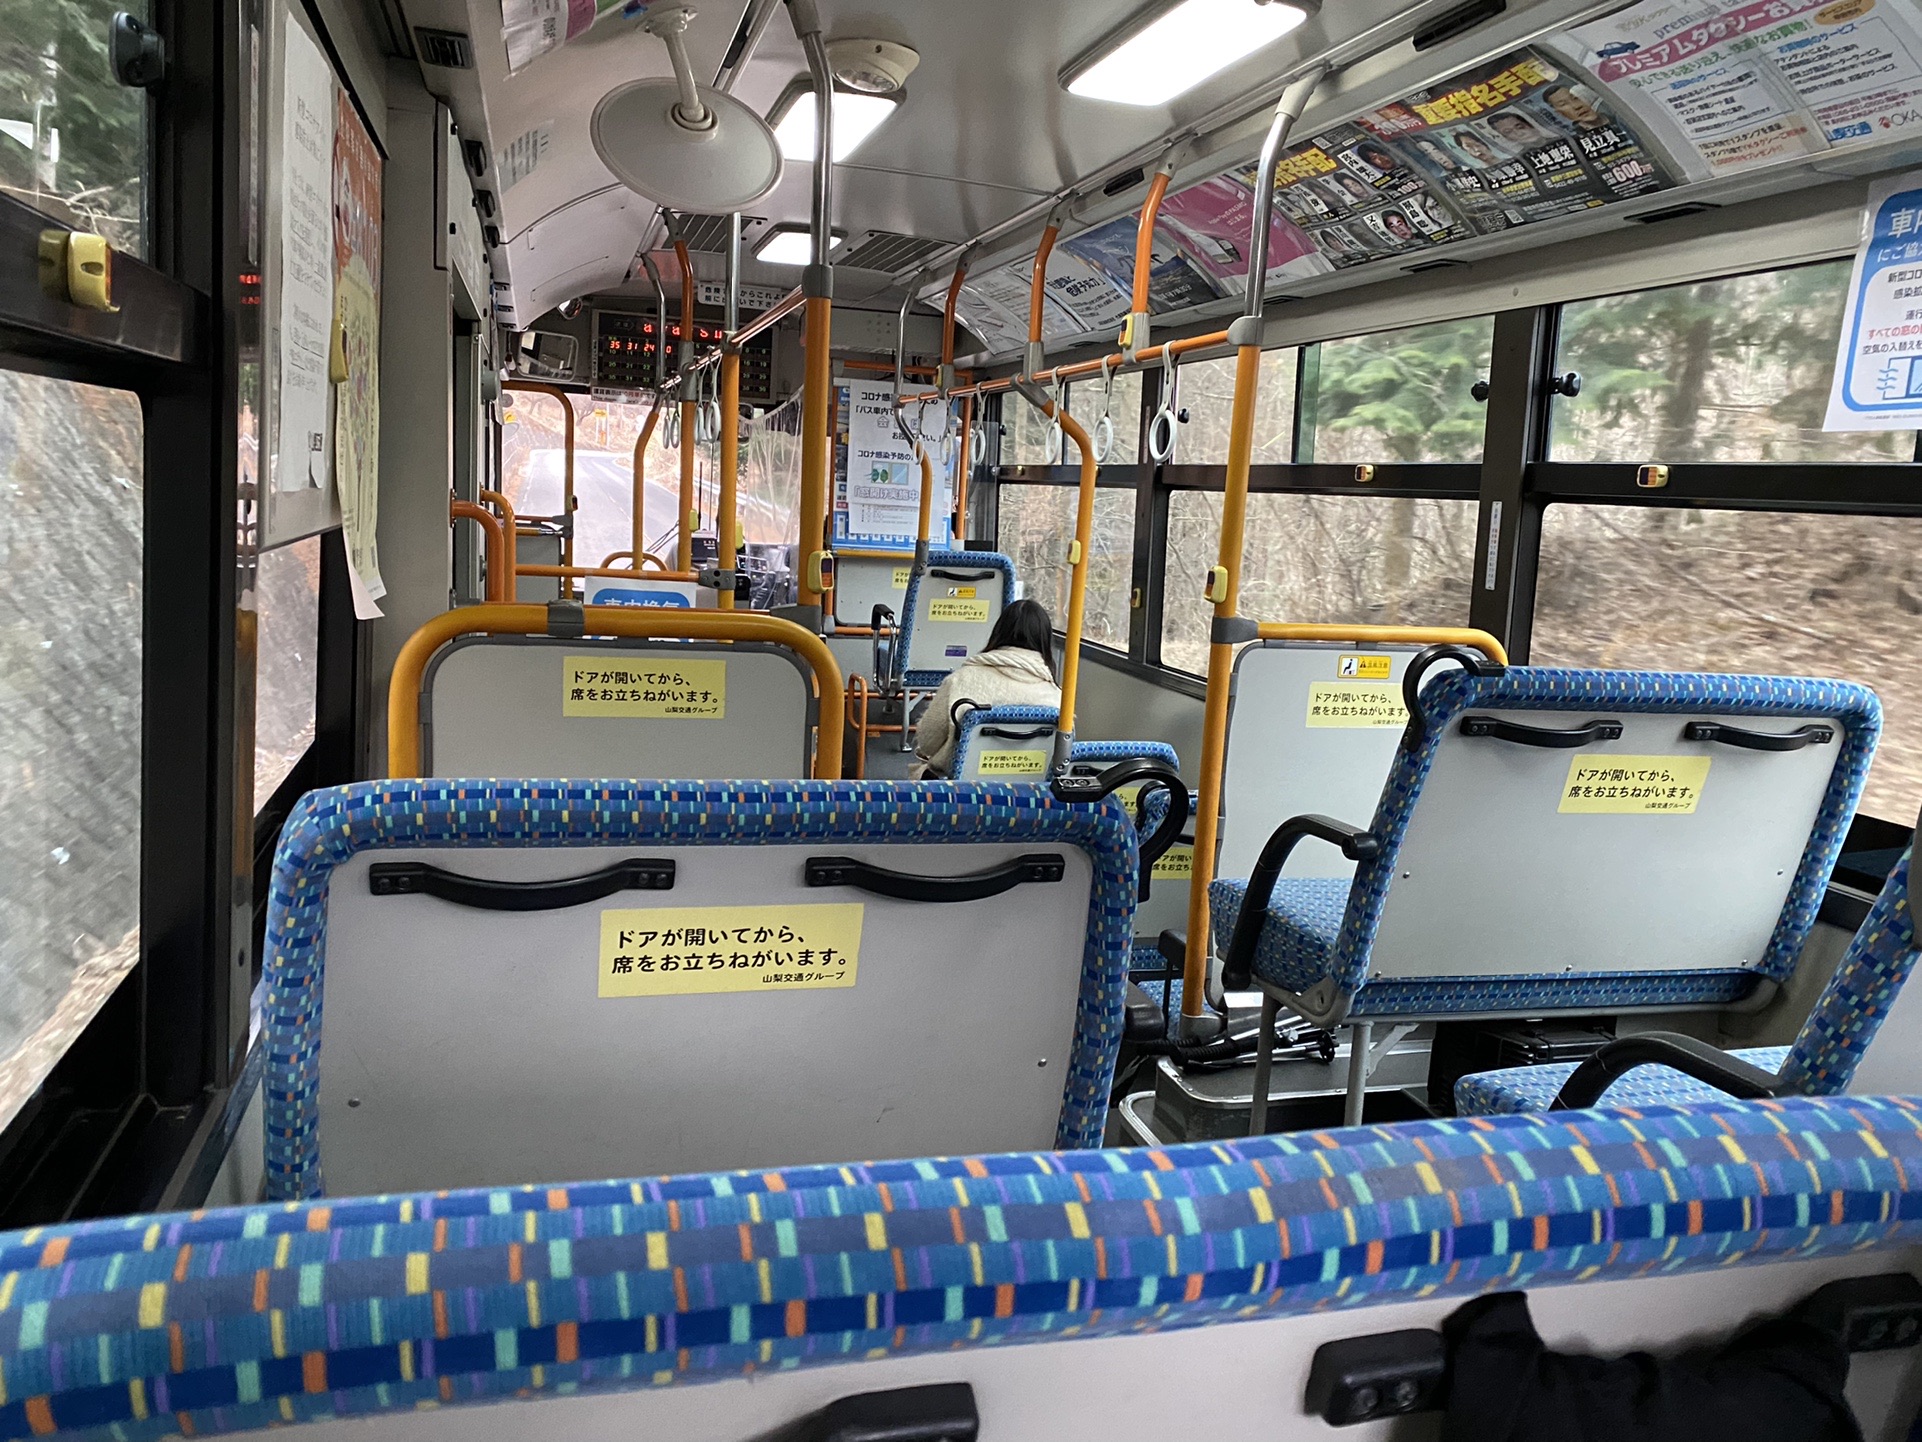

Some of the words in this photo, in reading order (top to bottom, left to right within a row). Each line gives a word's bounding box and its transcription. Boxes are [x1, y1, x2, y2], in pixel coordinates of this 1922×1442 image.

[1867, 322, 1922, 340] すべての窓の
[573, 671, 691, 686] ドアが開いてから、
[570, 688, 718, 703] 席をお立ちねがいます。
[1315, 693, 1392, 703] ドアが開いてから、
[665, 706, 718, 714] 山梨交通グループ
[1312, 706, 1409, 717] 席をお立ちねがいます。
[1576, 769, 1675, 782] ドアが開いてから、
[1568, 786, 1694, 799] 席をお立ちねがいます。
[617, 925, 805, 949] ドアが開いてから、
[612, 948, 847, 974] 席をお立ちねがいます。
[762, 971, 846, 983] 山梨交通グループ
